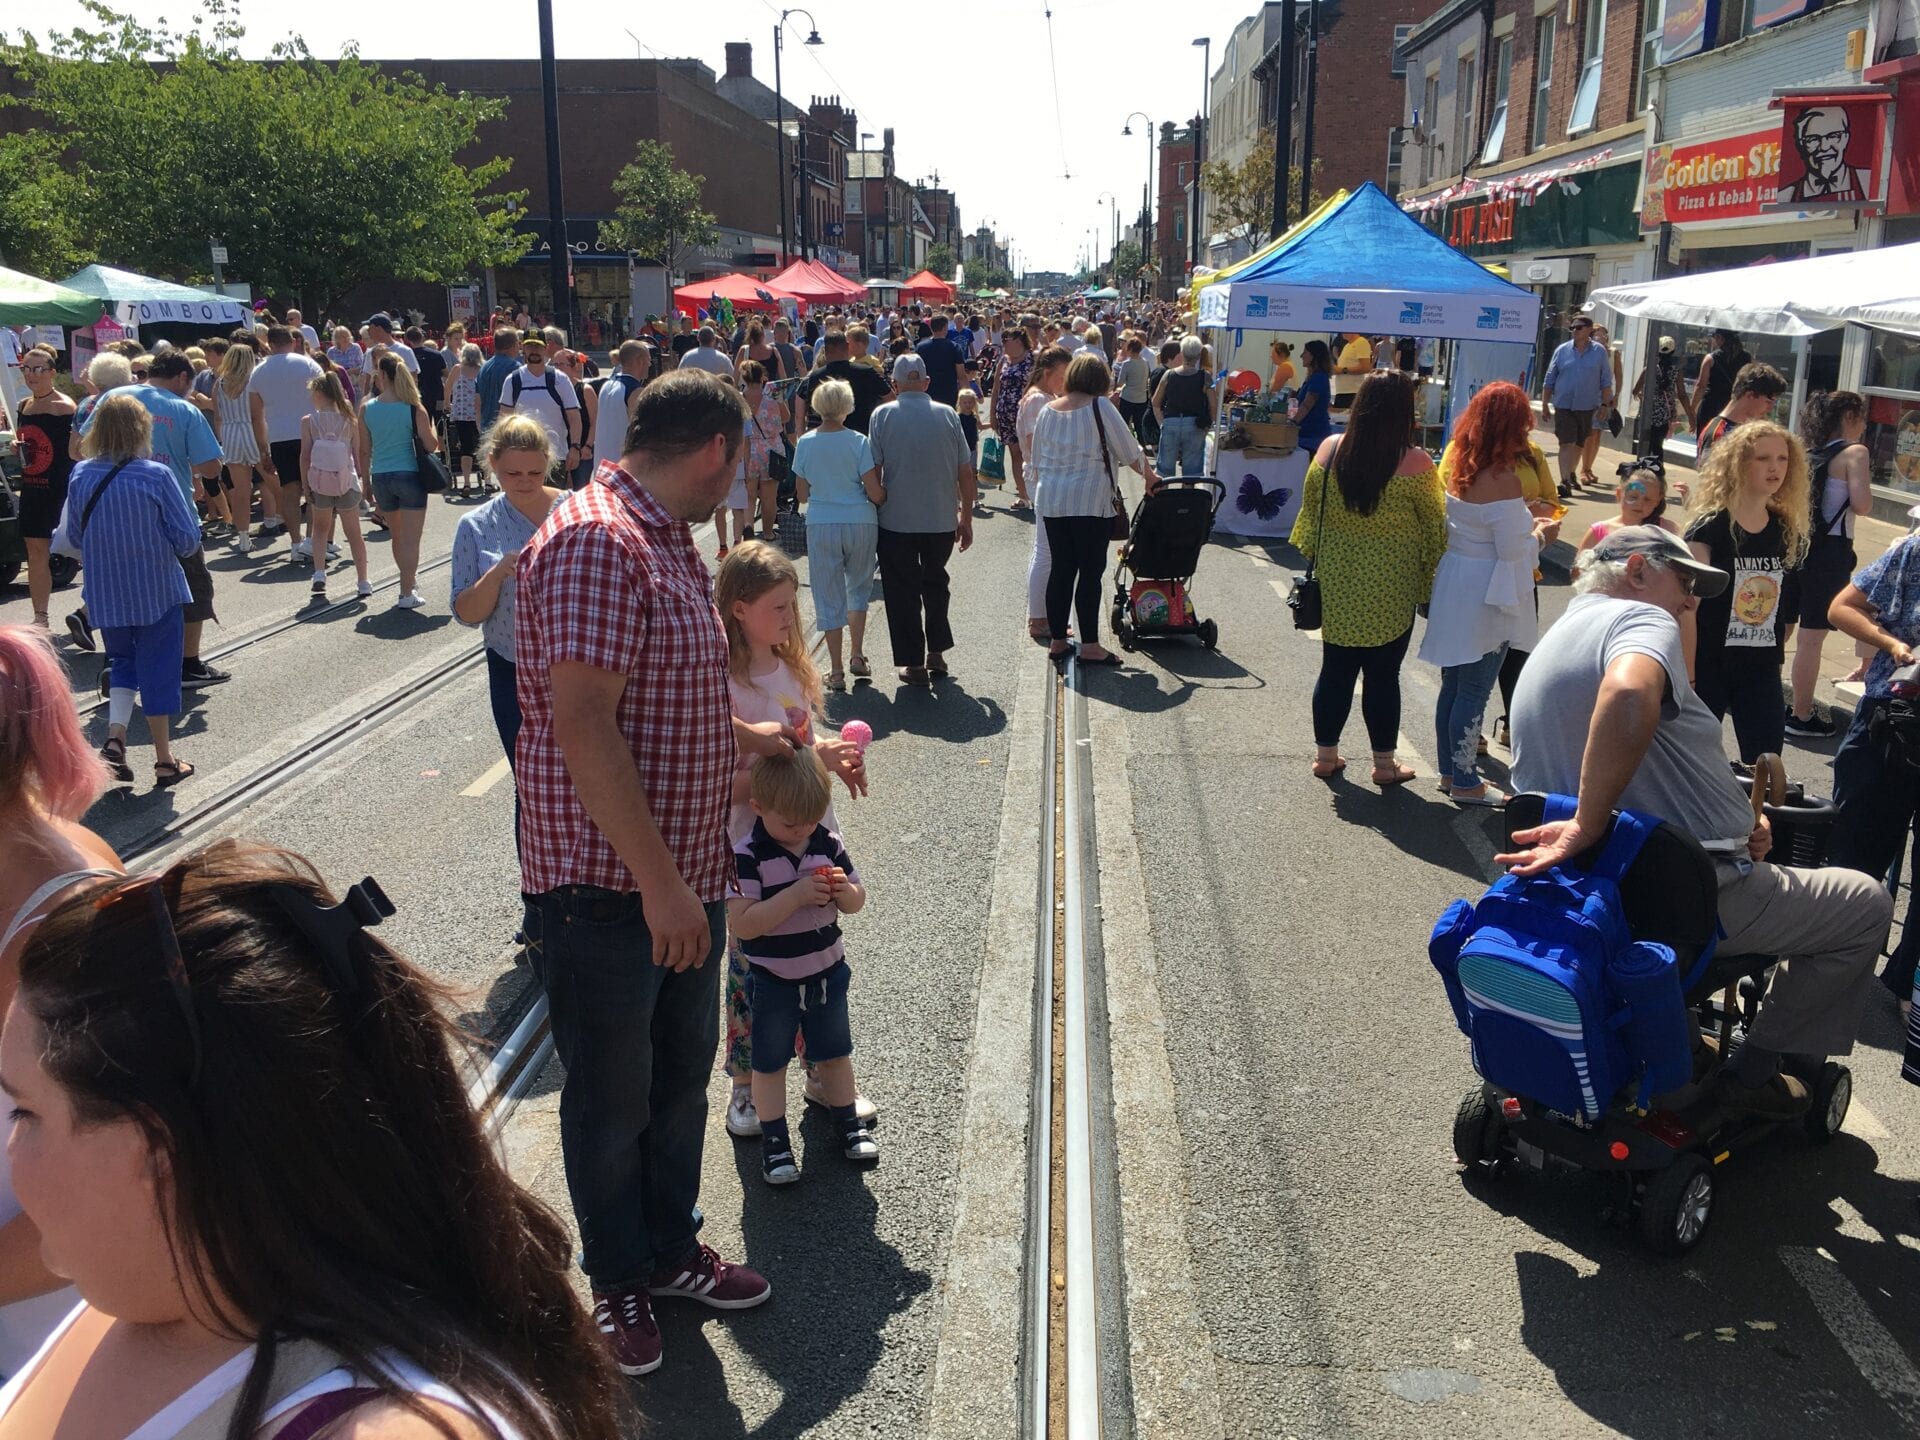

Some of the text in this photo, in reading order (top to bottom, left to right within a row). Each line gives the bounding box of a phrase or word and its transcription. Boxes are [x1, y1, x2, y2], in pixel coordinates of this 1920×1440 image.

[1664, 153, 1744, 191] Golden
[1678, 194, 1704, 210] Pizza
[1708, 191, 1715, 207] &
[1718, 187, 1753, 206] Kebab
[1424, 304, 1443, 312] giving
[1734, 557, 1770, 570] ALWAYS
